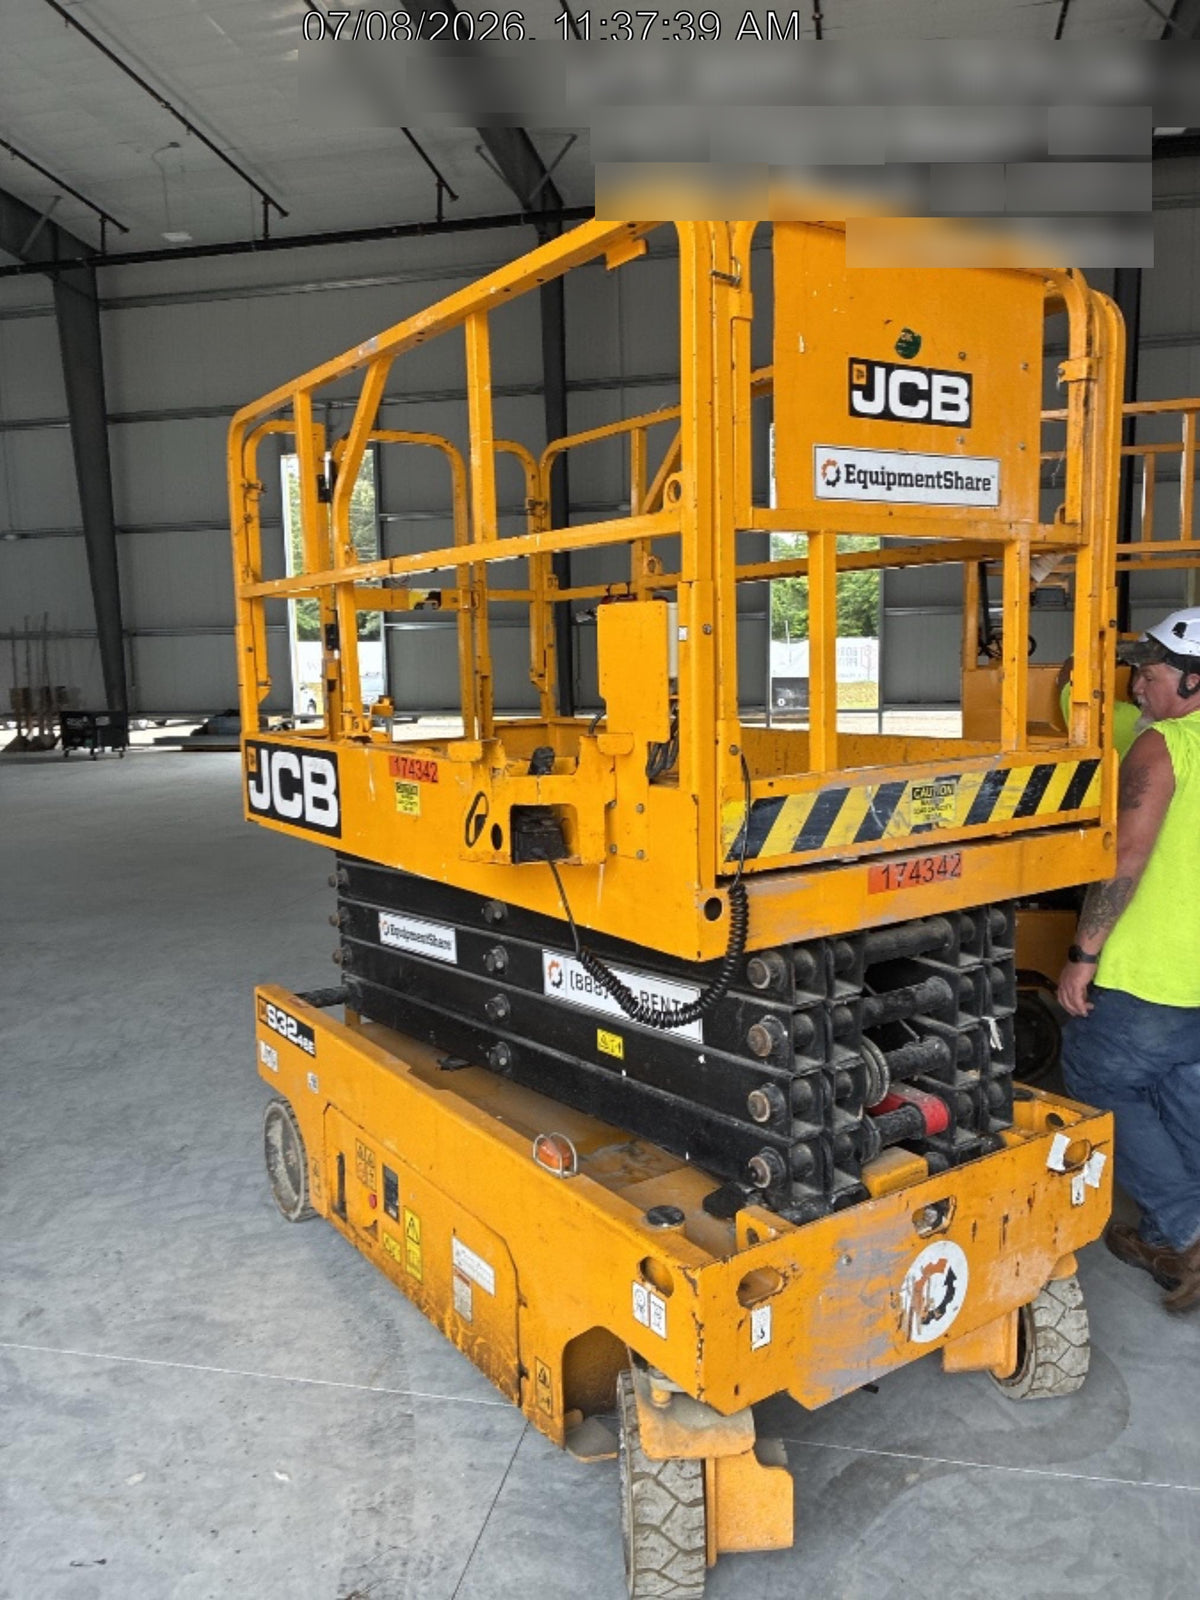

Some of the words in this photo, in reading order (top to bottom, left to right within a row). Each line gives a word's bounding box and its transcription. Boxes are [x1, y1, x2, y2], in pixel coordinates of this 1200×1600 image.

[852, 366, 970, 423] JCB
[844, 464, 992, 492] EquipmentShare
[394, 756, 438, 783] 174342
[249, 748, 339, 828] JCB
[913, 785, 953, 799] CAUON
[881, 853, 961, 889] 174342
